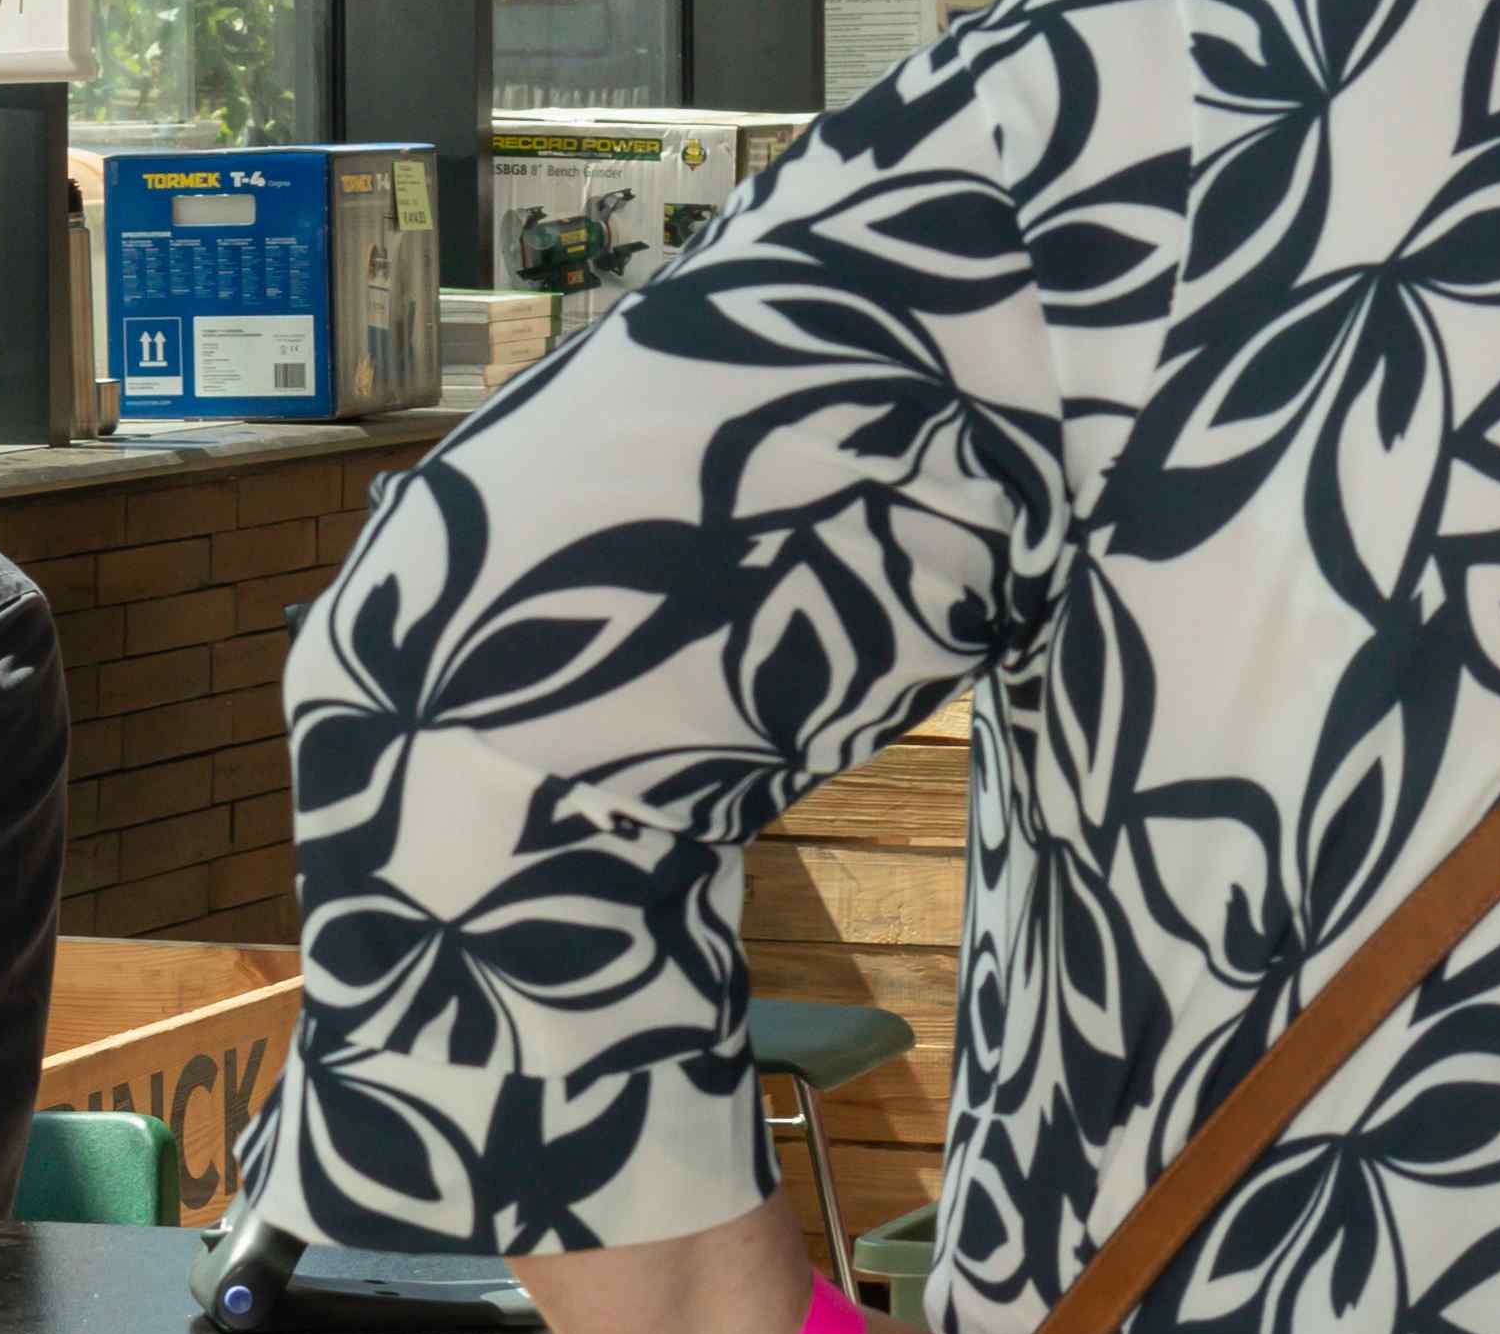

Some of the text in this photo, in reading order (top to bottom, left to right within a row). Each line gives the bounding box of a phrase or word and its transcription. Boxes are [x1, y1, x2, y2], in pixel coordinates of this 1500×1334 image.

[492, 136, 662, 154] RECORD POWER
[494, 164, 528, 177] SBG8
[142, 171, 222, 190] TORMEK
[229, 170, 266, 188] T-4
